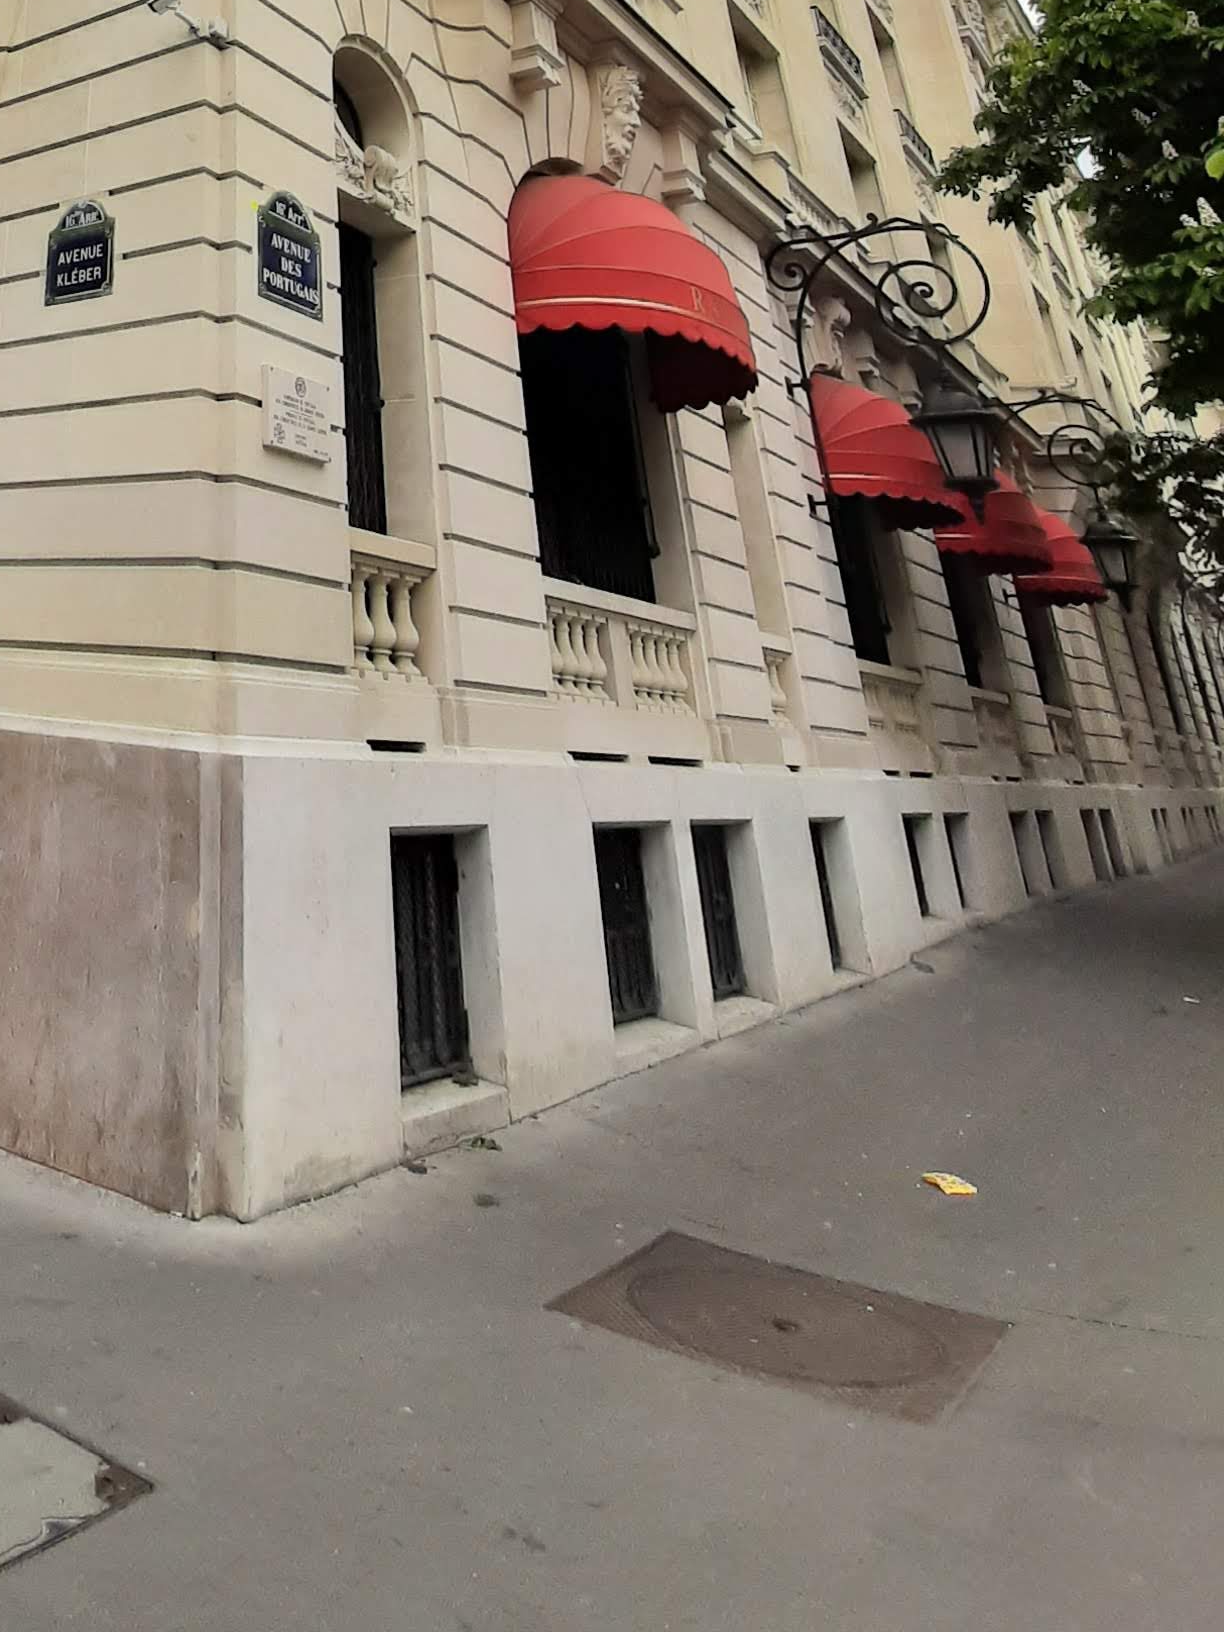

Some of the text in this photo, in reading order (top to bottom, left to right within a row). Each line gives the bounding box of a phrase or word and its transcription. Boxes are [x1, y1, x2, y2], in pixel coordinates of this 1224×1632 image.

[57, 243, 104, 267] AVENUE
[271, 233, 312, 264] AVENUE
[56, 266, 102, 288] KLÉBER
[280, 256, 303, 278] DES
[262, 267, 320, 305] PORTUGAIS
